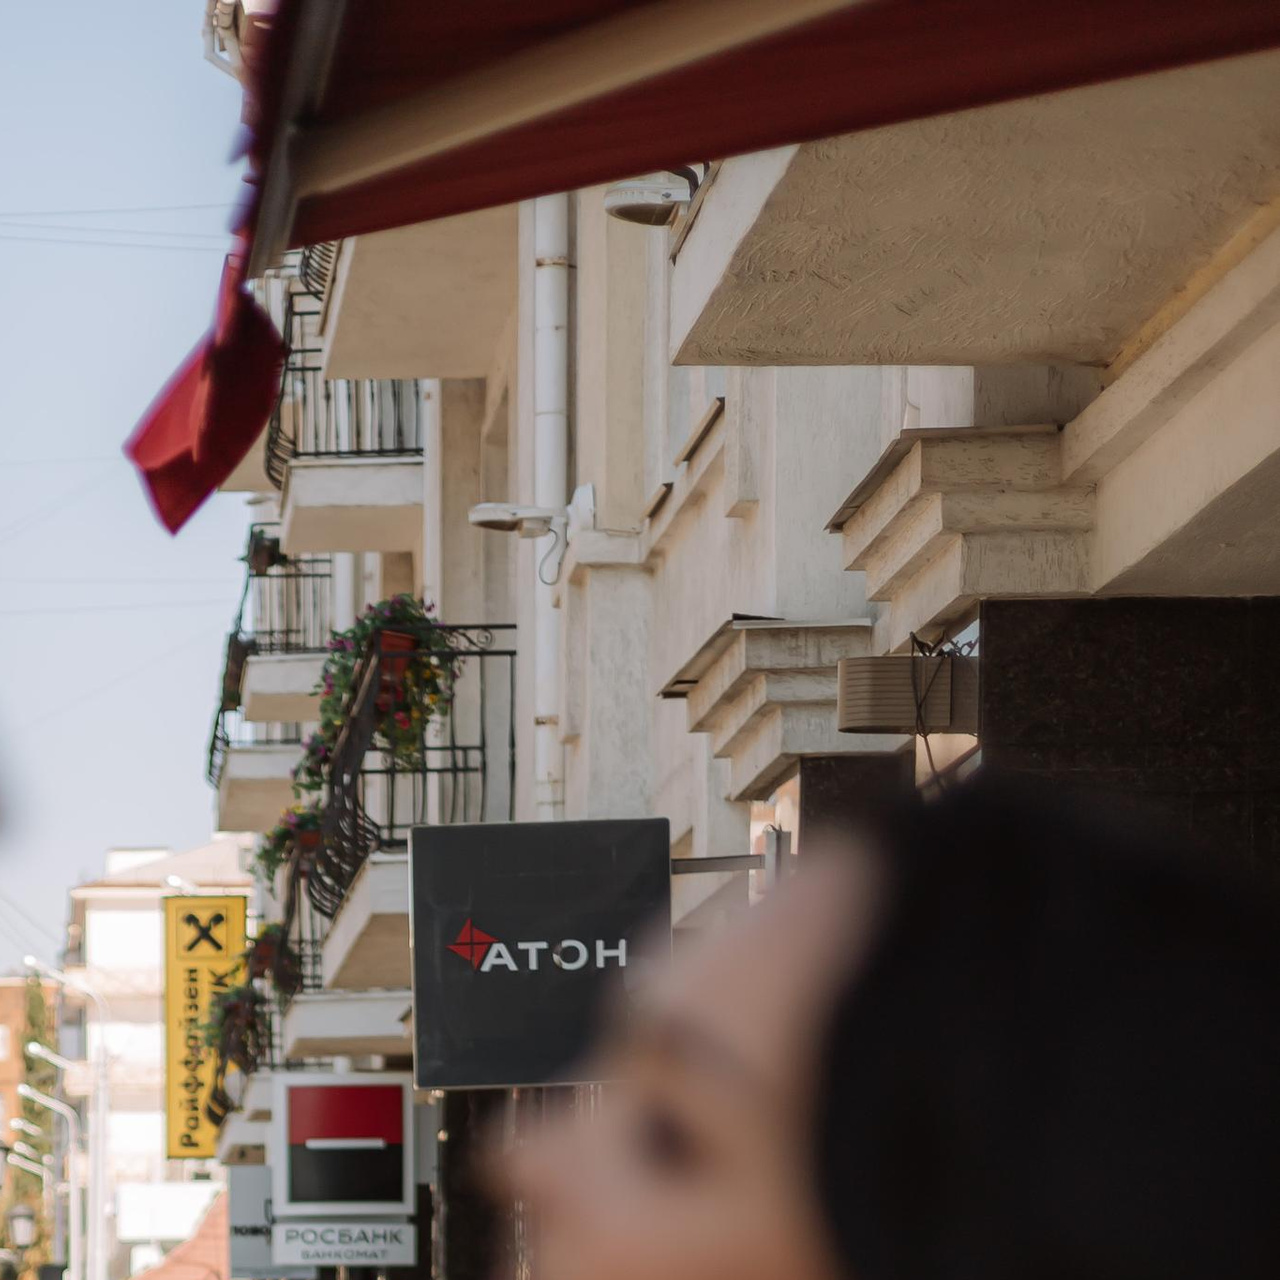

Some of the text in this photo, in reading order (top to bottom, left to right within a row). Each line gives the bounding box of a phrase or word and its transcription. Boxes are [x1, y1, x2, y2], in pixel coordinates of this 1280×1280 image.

[480, 938, 627, 972] АТОН
[179, 968, 204, 1148] Райффайзен
[284, 1228, 403, 1245] РОСБАНК
[300, 1249, 388, 1260] БАНКОМАТ
